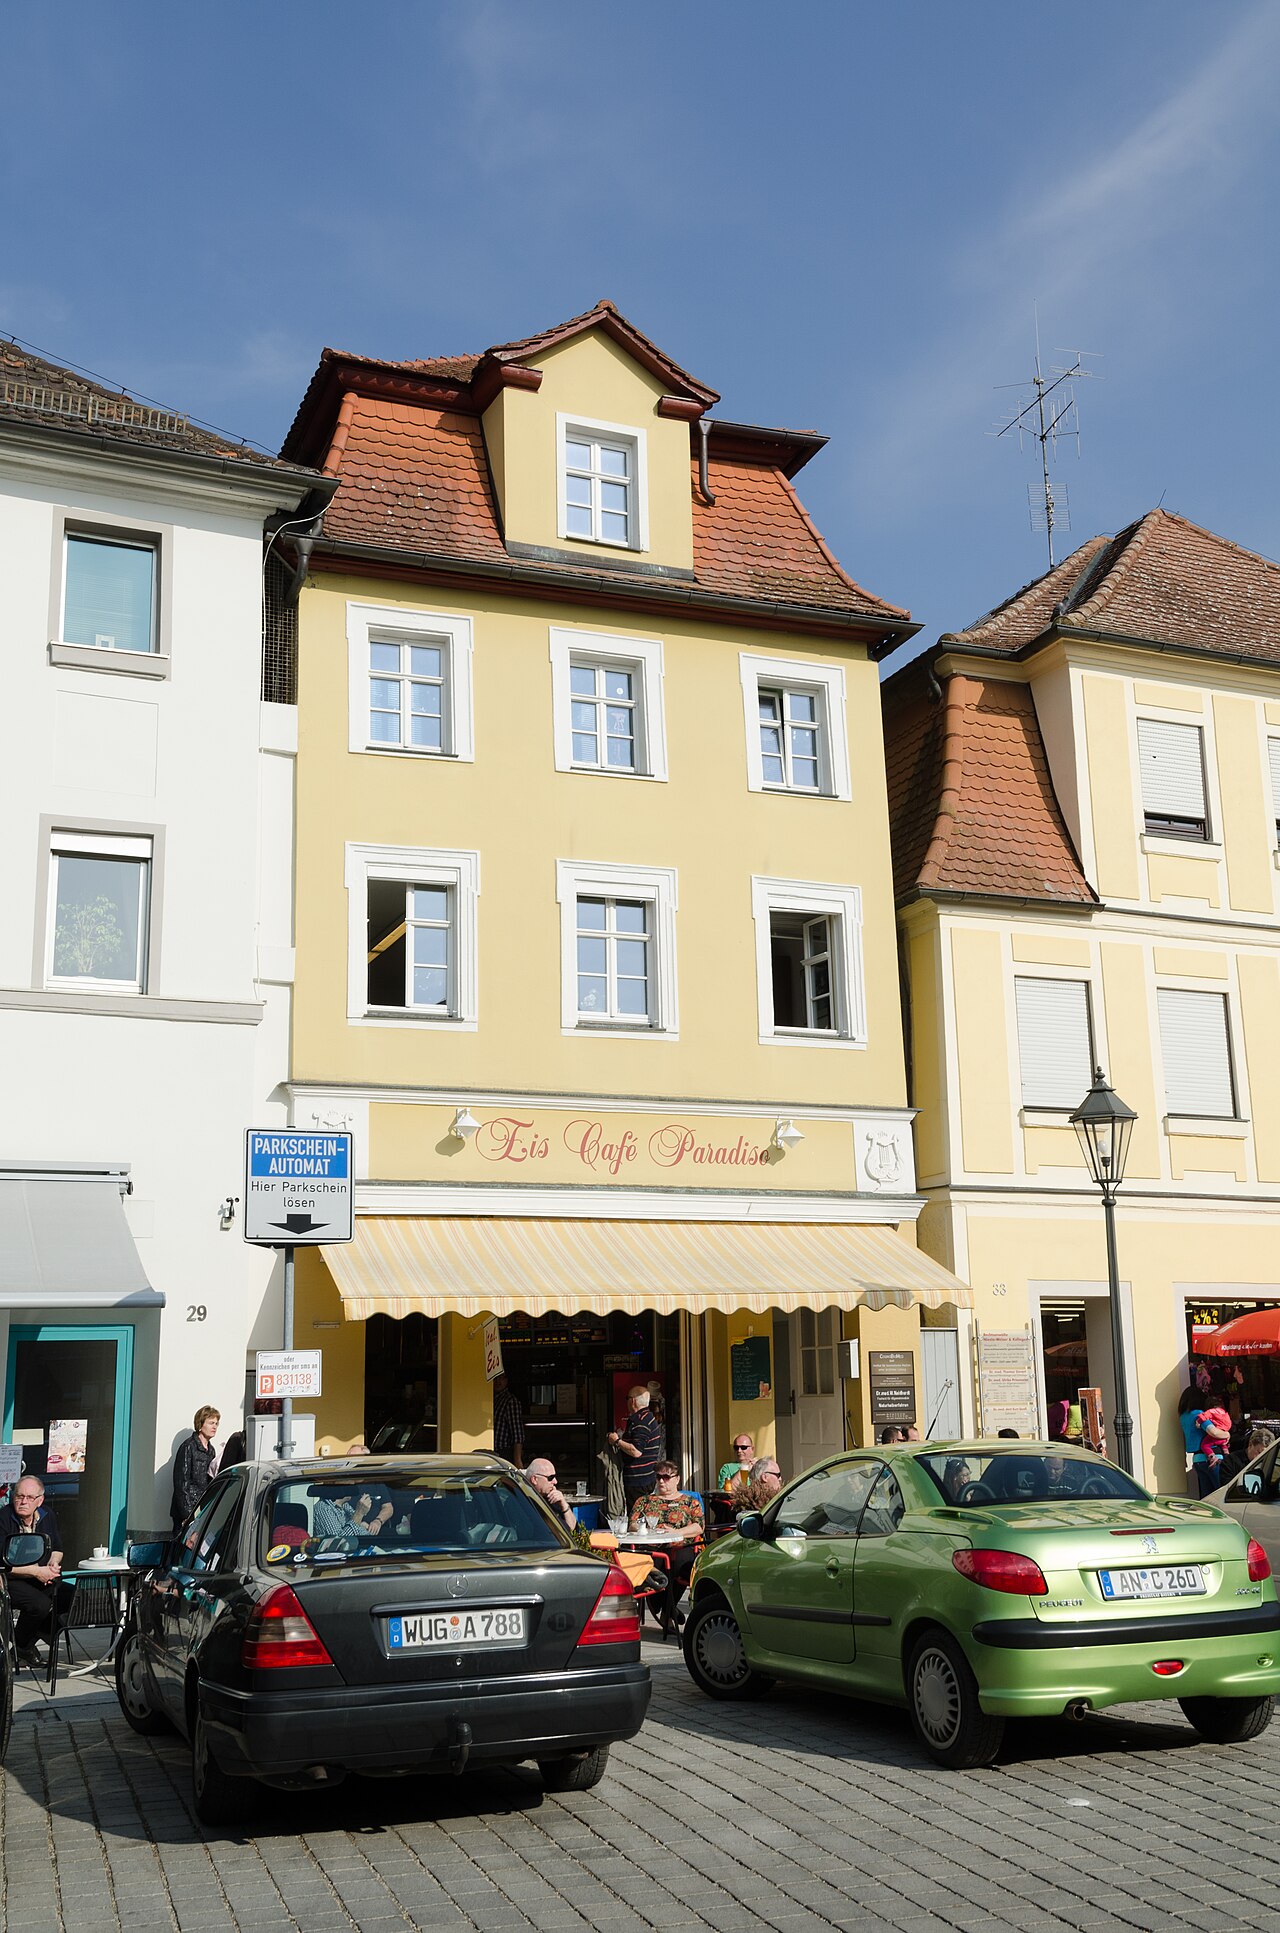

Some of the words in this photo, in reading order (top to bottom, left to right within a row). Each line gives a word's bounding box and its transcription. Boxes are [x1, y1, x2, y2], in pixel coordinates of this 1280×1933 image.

[255, 1137, 345, 1156] PARKSCHEIN-
[475, 1117, 549, 1163] Eis
[563, 1119, 638, 1175] Café
[648, 1124, 771, 1167] Paradiso
[269, 1157, 330, 1175] AUTOMAT
[251, 1181, 276, 1191] Hier
[282, 1181, 347, 1193] Parkschein
[283, 1197, 315, 1207] lösen
[186, 1304, 207, 1322] 29
[487, 1350, 500, 1374] Eis
[276, 1374, 312, 1385] 831138
[1120, 1572, 1141, 1593] AN
[1150, 1571, 1163, 1590] C
[1168, 1568, 1197, 1589] 260
[1039, 1599, 1085, 1609] PEUGEOT
[393, 1635, 400, 1643] D
[404, 1616, 448, 1642] WUG
[463, 1617, 476, 1638] A
[481, 1613, 521, 1636] 788
